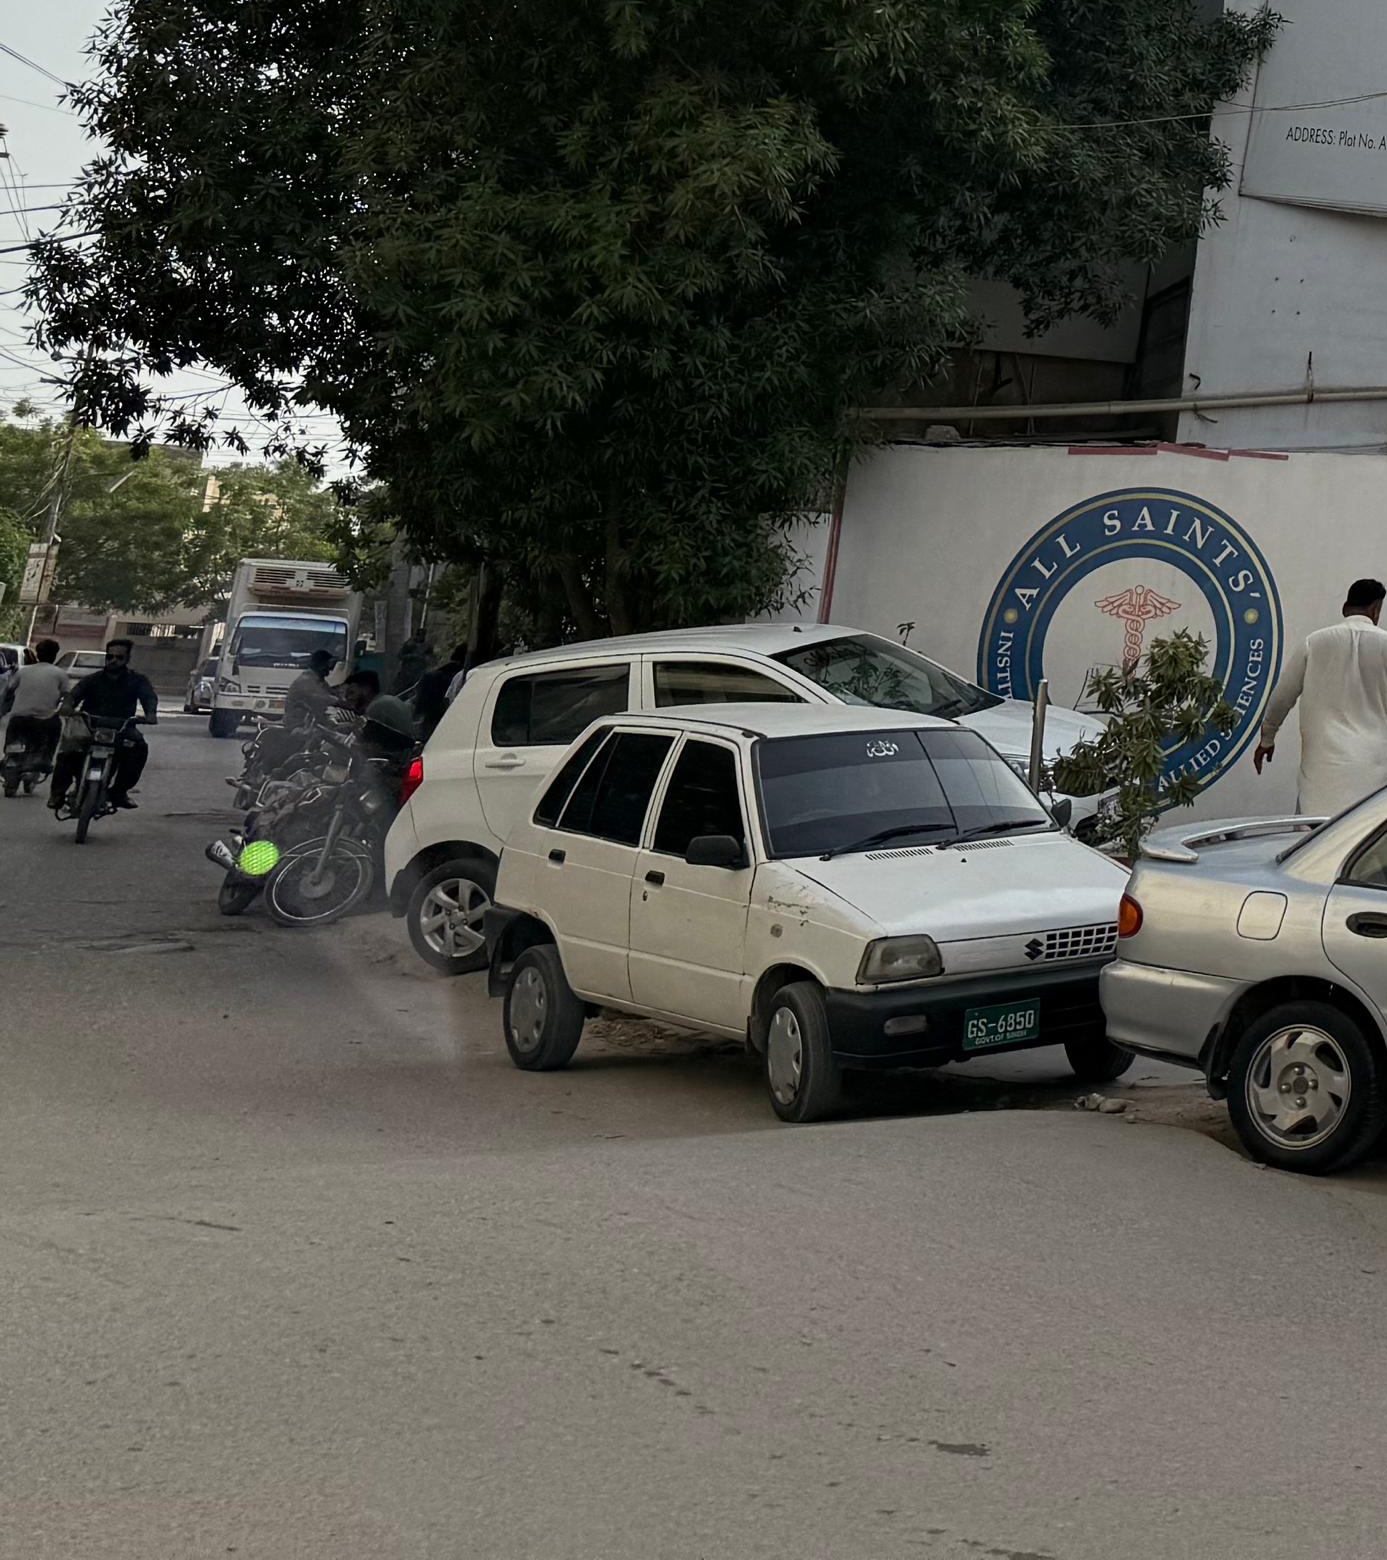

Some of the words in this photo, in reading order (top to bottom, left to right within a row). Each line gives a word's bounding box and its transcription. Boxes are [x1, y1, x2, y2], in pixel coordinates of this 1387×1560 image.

[1286, 126, 1336, 145] ADDRESS:
[1338, 130, 1356, 147] Plot
[1358, 133, 1376, 150] No.
[1014, 534, 1080, 610] ALL
[1103, 506, 1261, 600] SAINTS'
[967, 1009, 1034, 1039] GS-6850
